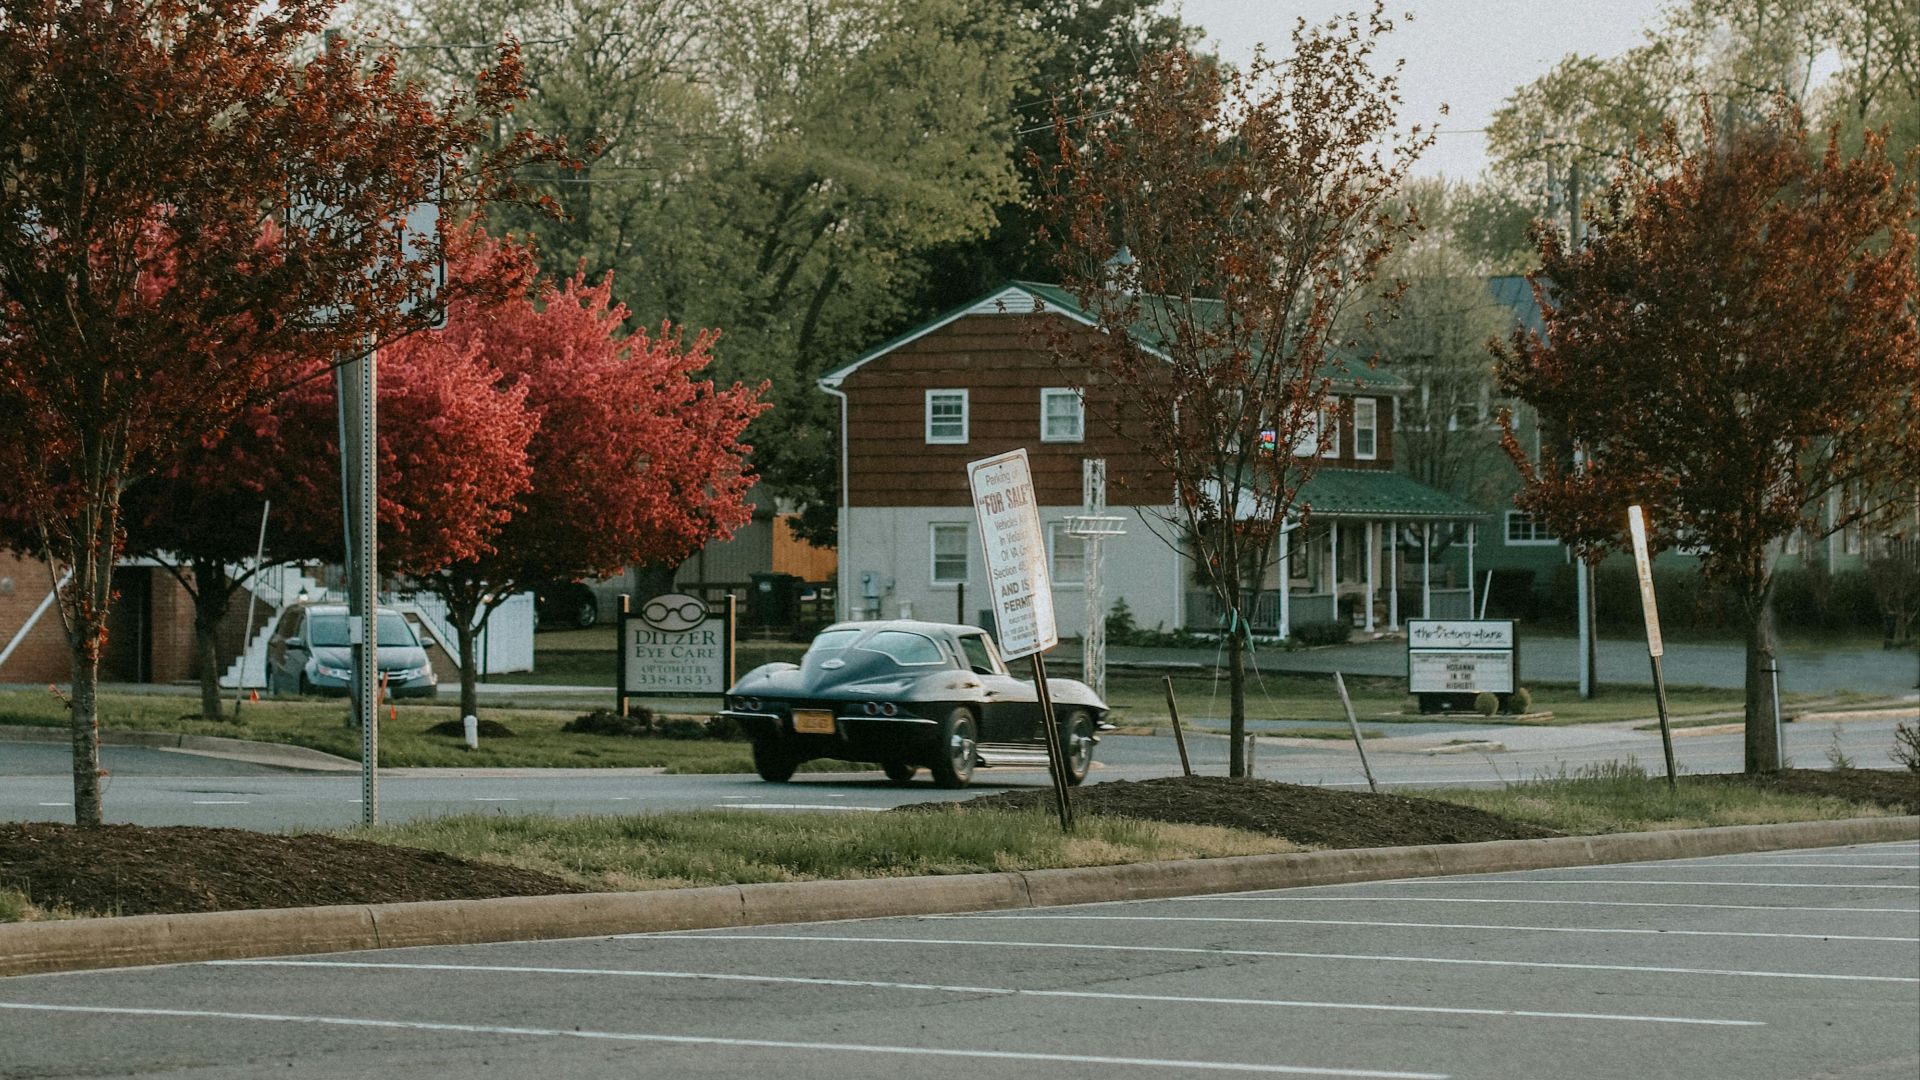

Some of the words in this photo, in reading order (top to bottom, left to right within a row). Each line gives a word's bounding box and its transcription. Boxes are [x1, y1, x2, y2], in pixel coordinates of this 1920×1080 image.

[985, 472, 1011, 487] Parking
[993, 565, 1018, 580] Section
[1001, 582, 1020, 598] AND
[1021, 580, 1030, 592] IS
[635, 630, 716, 645] DILZER
[636, 646, 665, 658] EYE
[671, 646, 716, 658] CARE
[642, 665, 707, 674] OPTOMETRY
